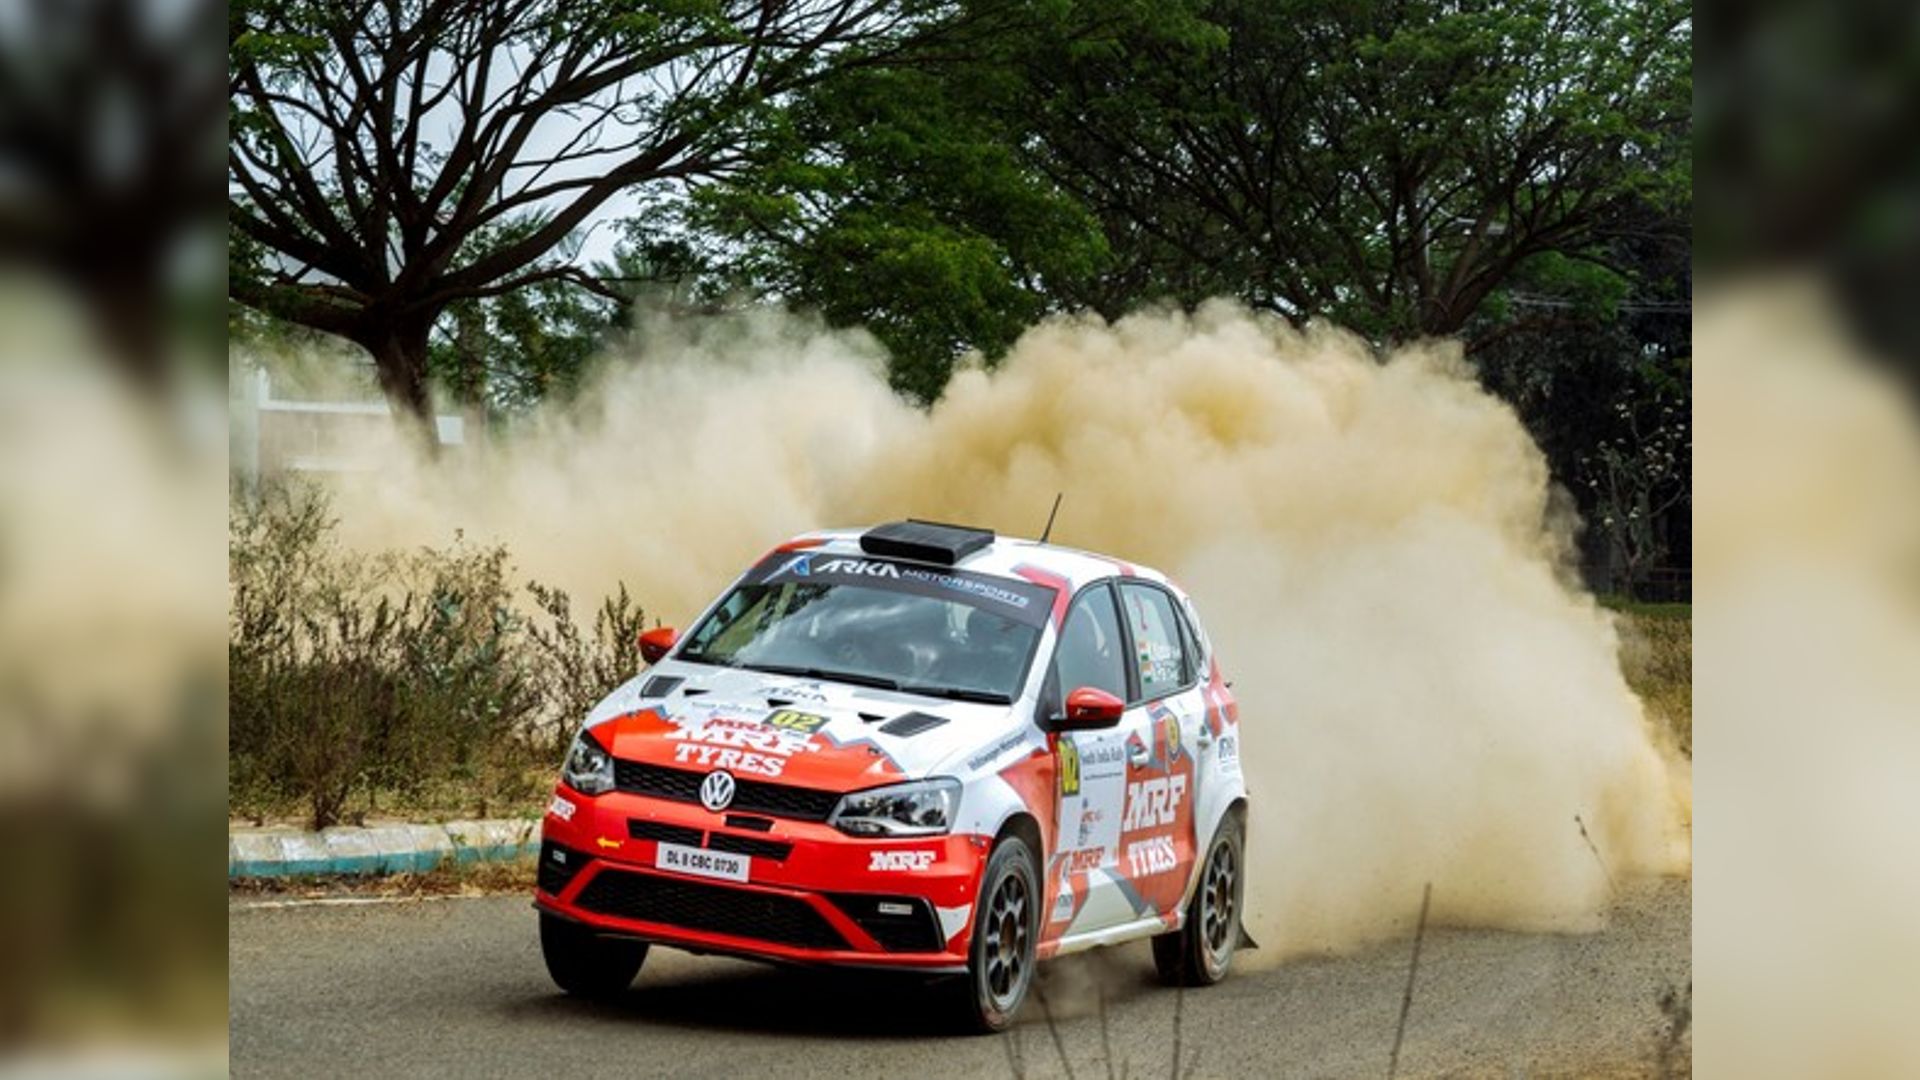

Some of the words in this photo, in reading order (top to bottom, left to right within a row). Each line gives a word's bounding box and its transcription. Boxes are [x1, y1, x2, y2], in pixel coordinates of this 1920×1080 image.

[814, 559, 900, 578] ARKA
[902, 568, 1030, 608] MOTORSPORTS
[672, 717, 822, 757] MRF
[771, 711, 821, 732] 02
[675, 743, 787, 778] TYRES
[1123, 774, 1186, 832] MRF
[667, 849, 679, 864] DL
[868, 849, 936, 872] MRF
